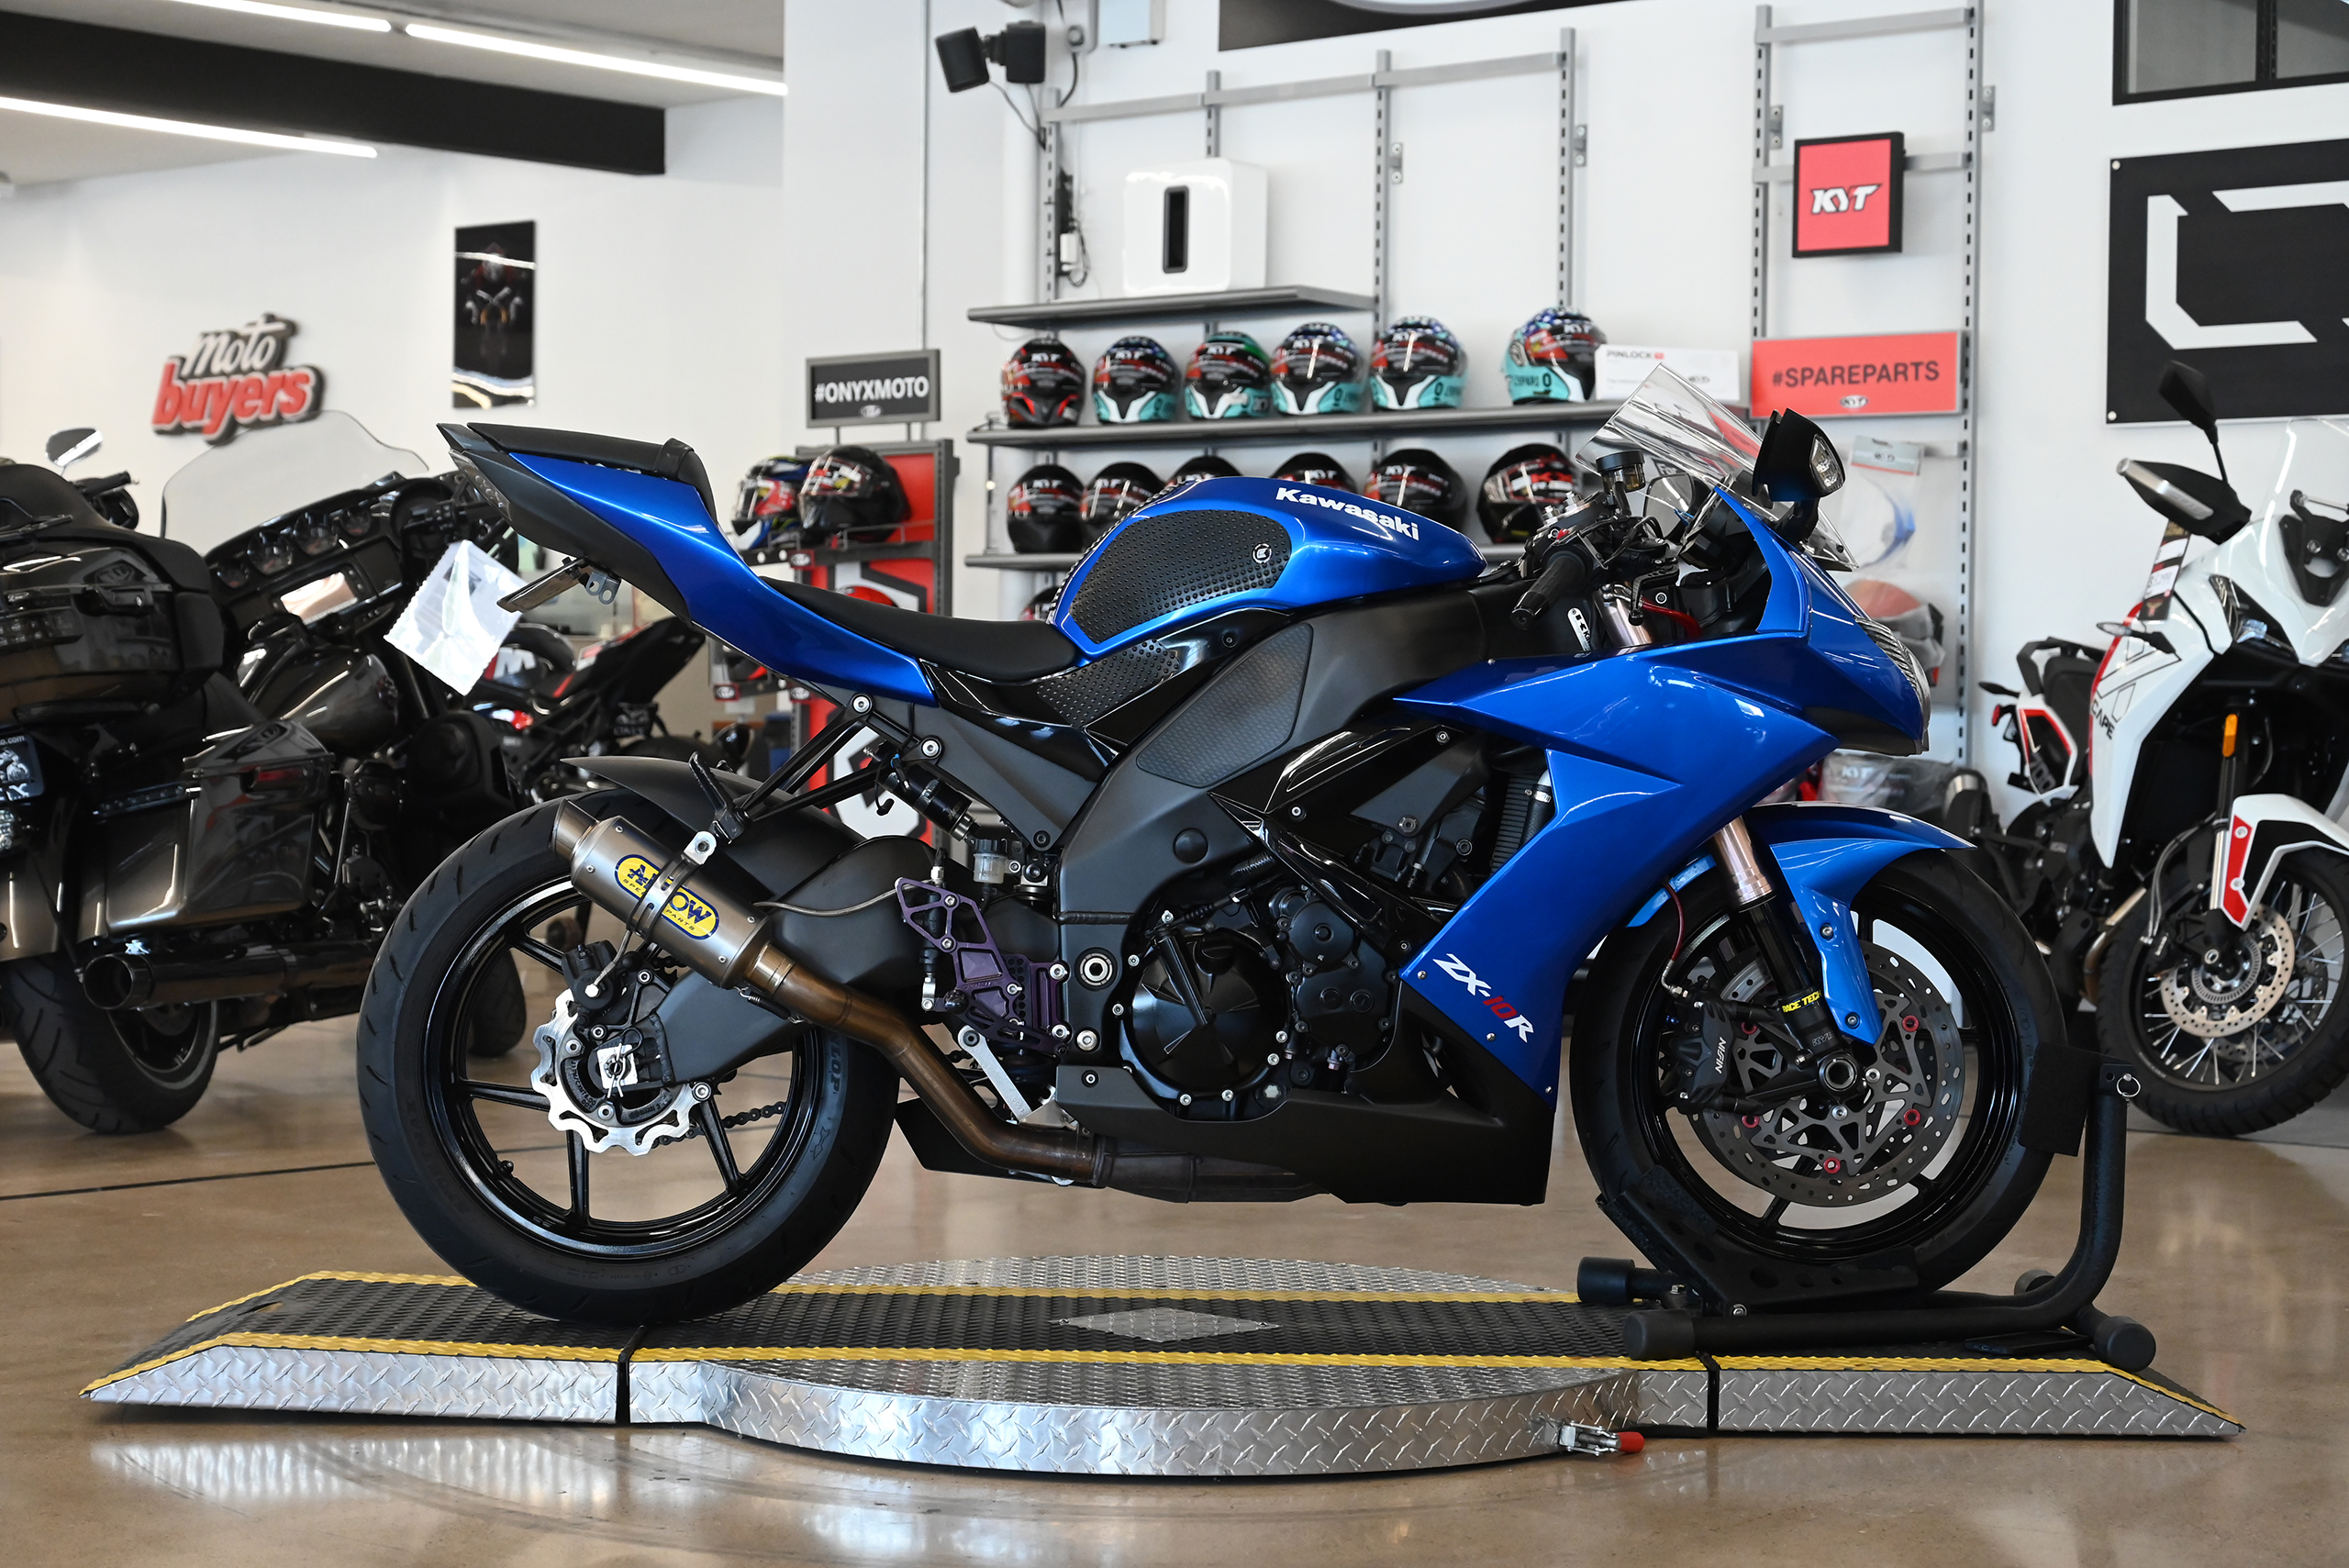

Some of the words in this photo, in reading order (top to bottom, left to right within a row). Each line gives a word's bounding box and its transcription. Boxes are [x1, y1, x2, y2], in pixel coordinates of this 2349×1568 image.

[1810, 183, 1883, 215] KYT
[814, 375, 930, 404] #ONYXMOTO
[1772, 361, 1940, 388] #SPAREPARTS
[151, 361, 313, 438] buyers
[1275, 487, 1419, 540] Kawasaki
[0, 736, 25, 746] o.com
[627, 863, 712, 925] AOW
[666, 908, 696, 931] PARTS
[1432, 953, 1534, 1043] ZX-10R
[1782, 999, 1802, 1013] RACE
[1802, 990, 1822, 1006] TECH
[1714, 1036, 1727, 1074] NISSIN
